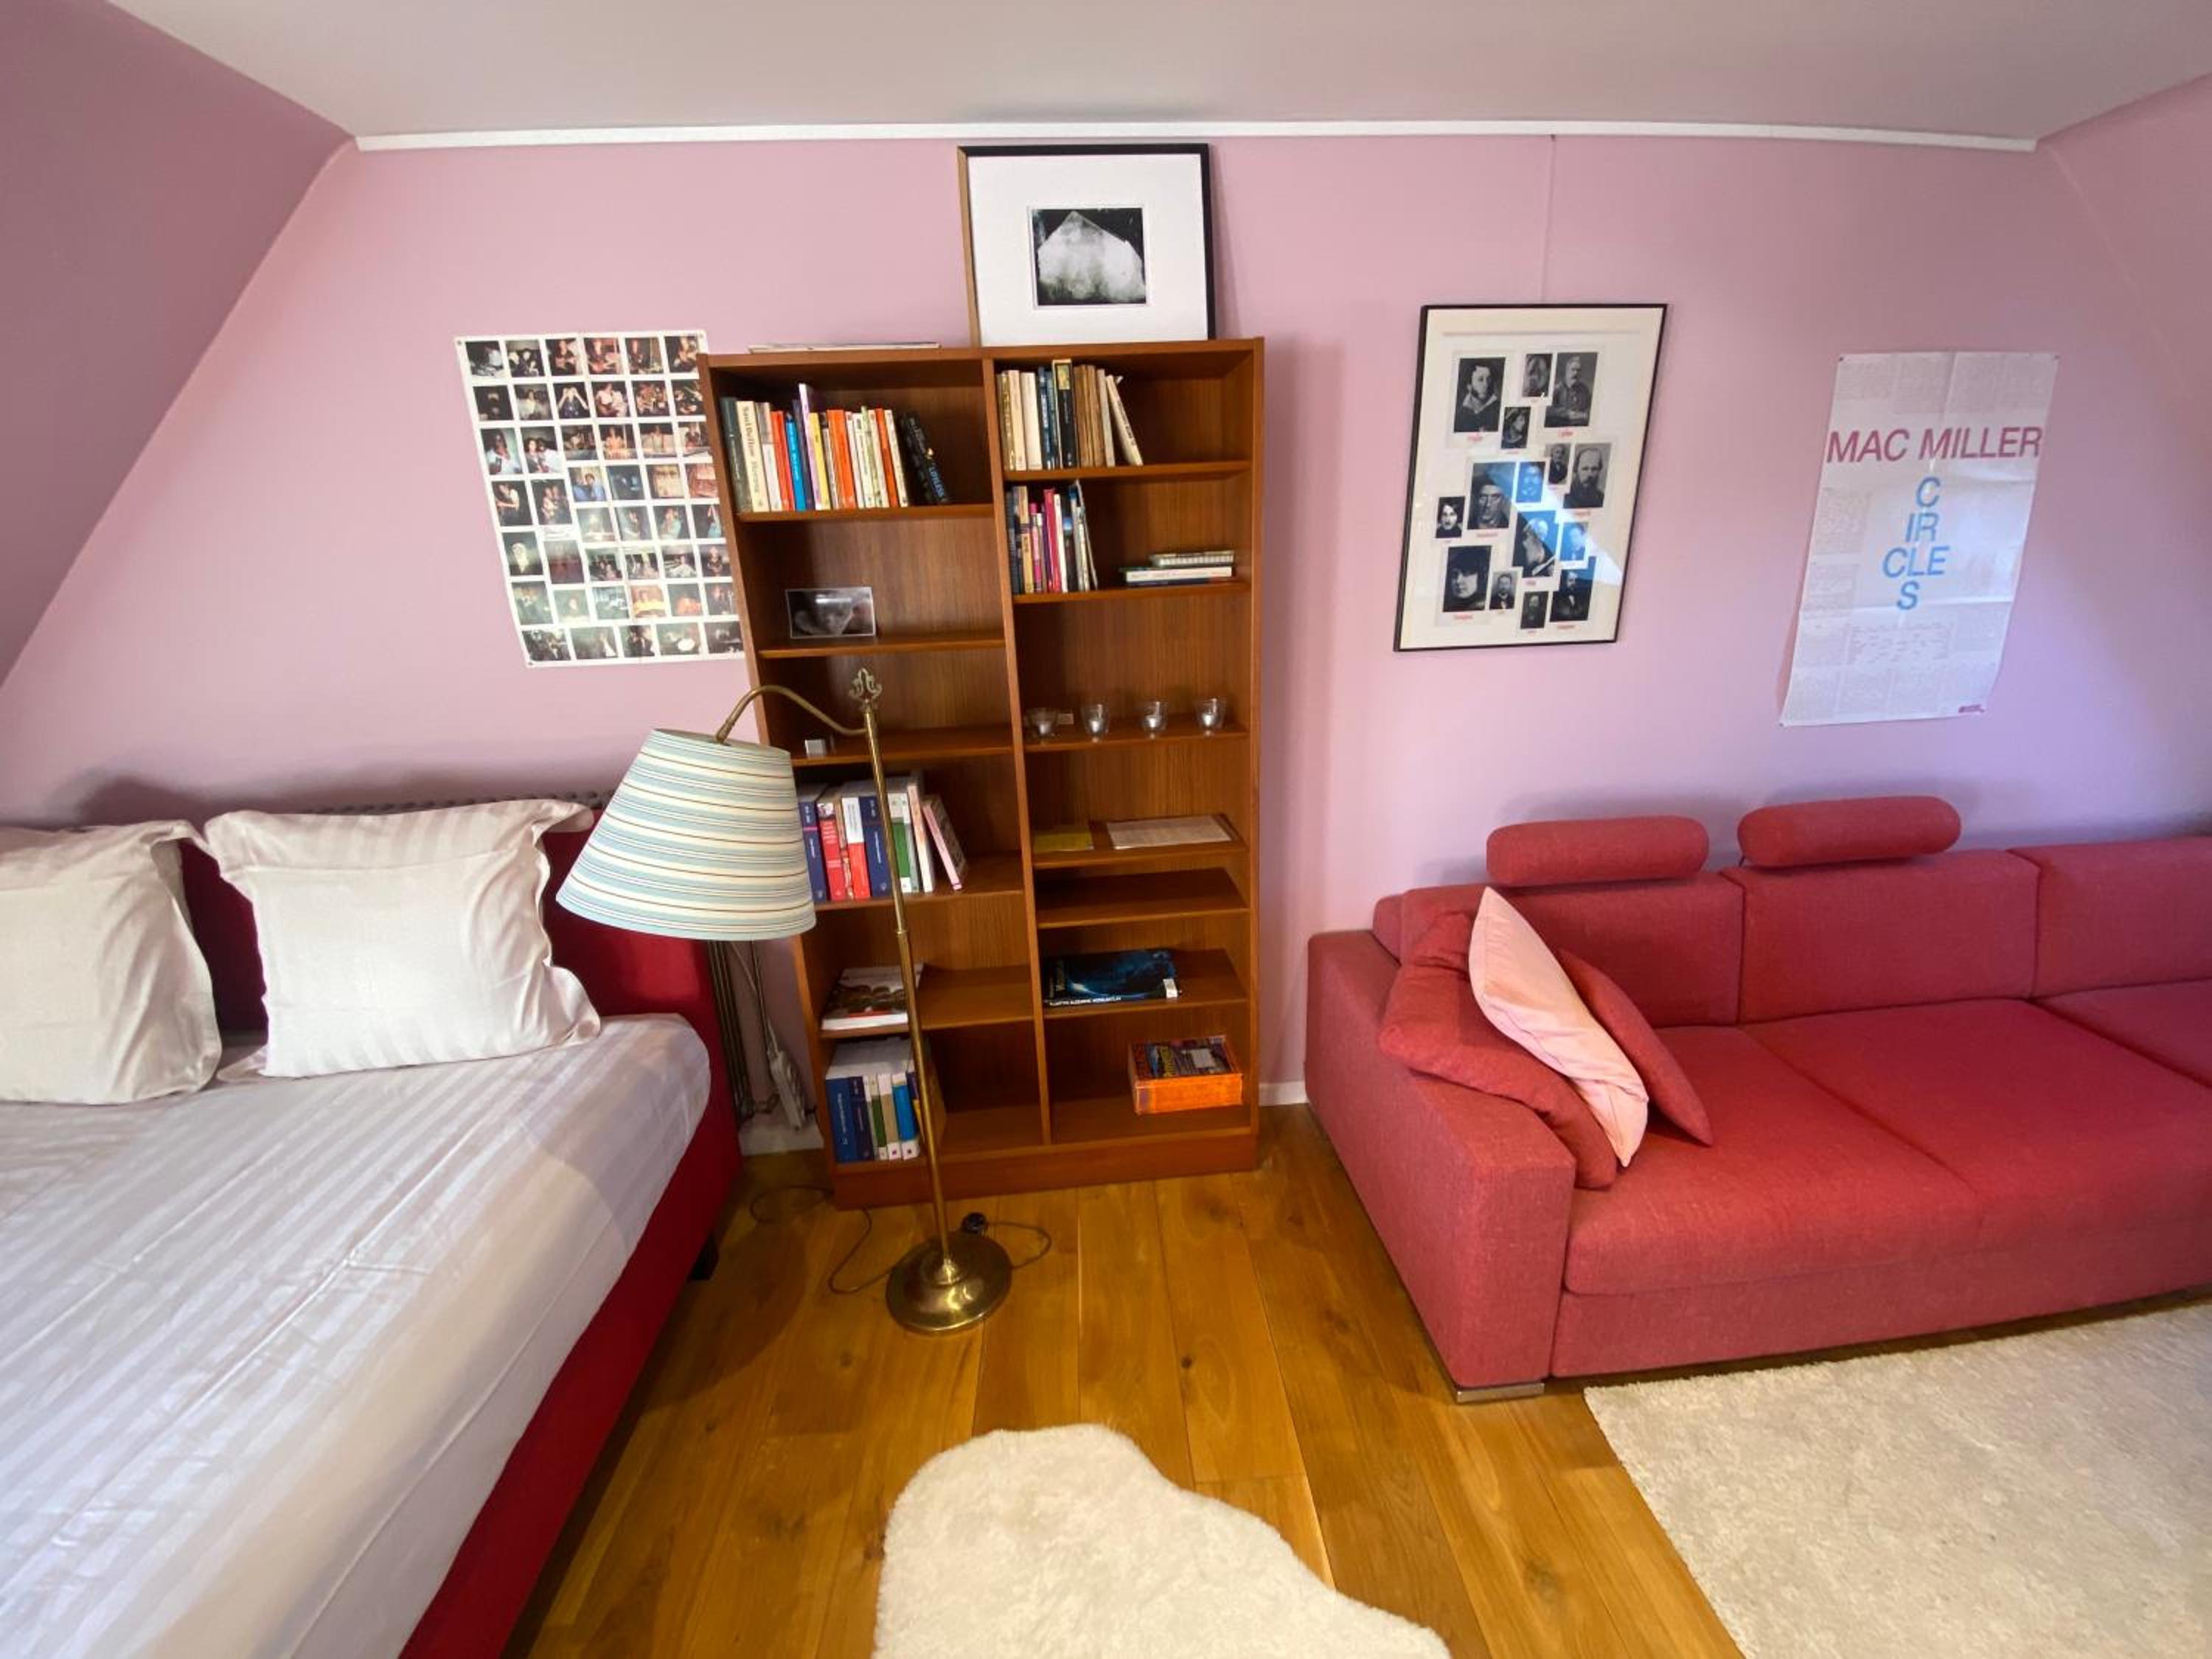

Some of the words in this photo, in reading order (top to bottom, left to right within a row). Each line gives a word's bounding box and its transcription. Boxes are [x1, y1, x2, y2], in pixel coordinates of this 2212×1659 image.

[1826, 428, 1910, 463] MAC
[1918, 427, 2043, 460] MILLER
[1916, 476, 1941, 508] C
[1905, 512, 1939, 543] IR
[1882, 546, 1950, 578] CLE
[1896, 581, 1919, 610] S
